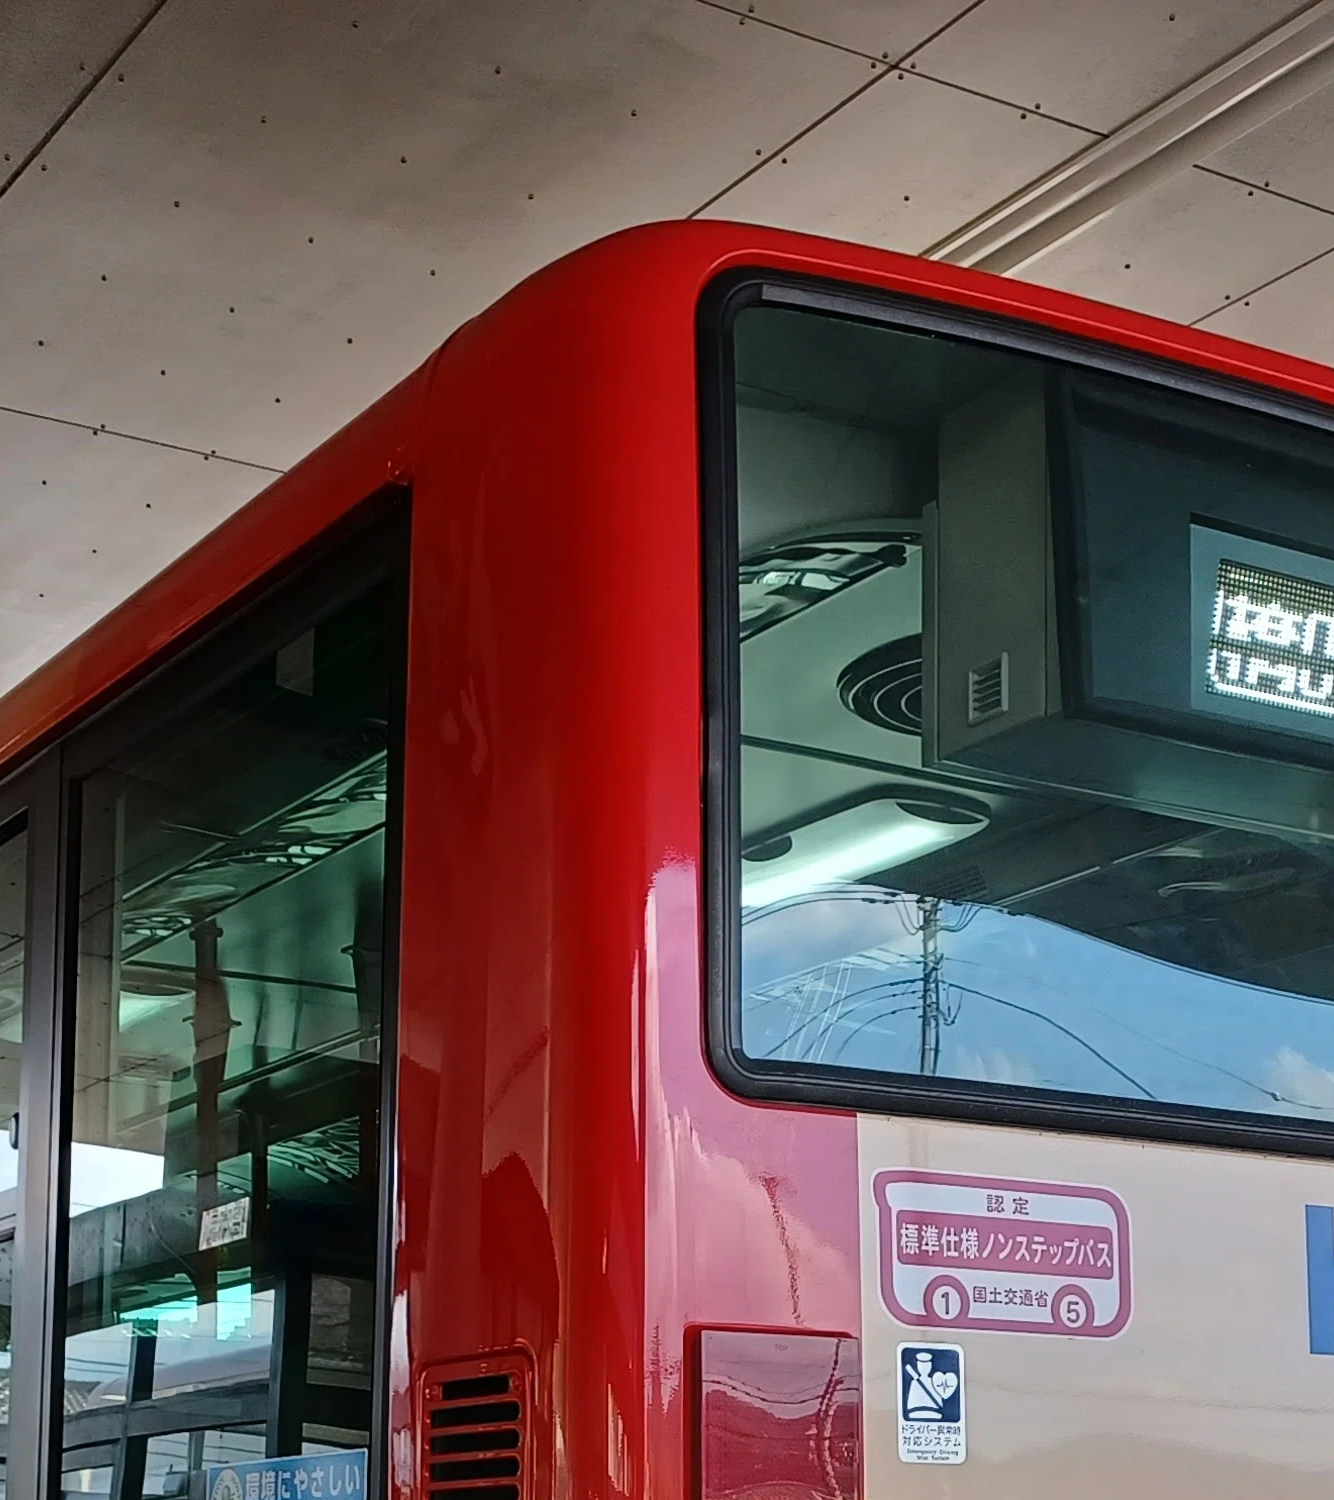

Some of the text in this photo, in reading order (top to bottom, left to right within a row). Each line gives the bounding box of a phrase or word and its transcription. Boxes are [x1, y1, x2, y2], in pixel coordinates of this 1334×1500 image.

[986, 1194, 1029, 1215] 認定
[900, 1223, 1112, 1268] 標準仕様ノンステップバス
[973, 1287, 1049, 1308] 国土交通省
